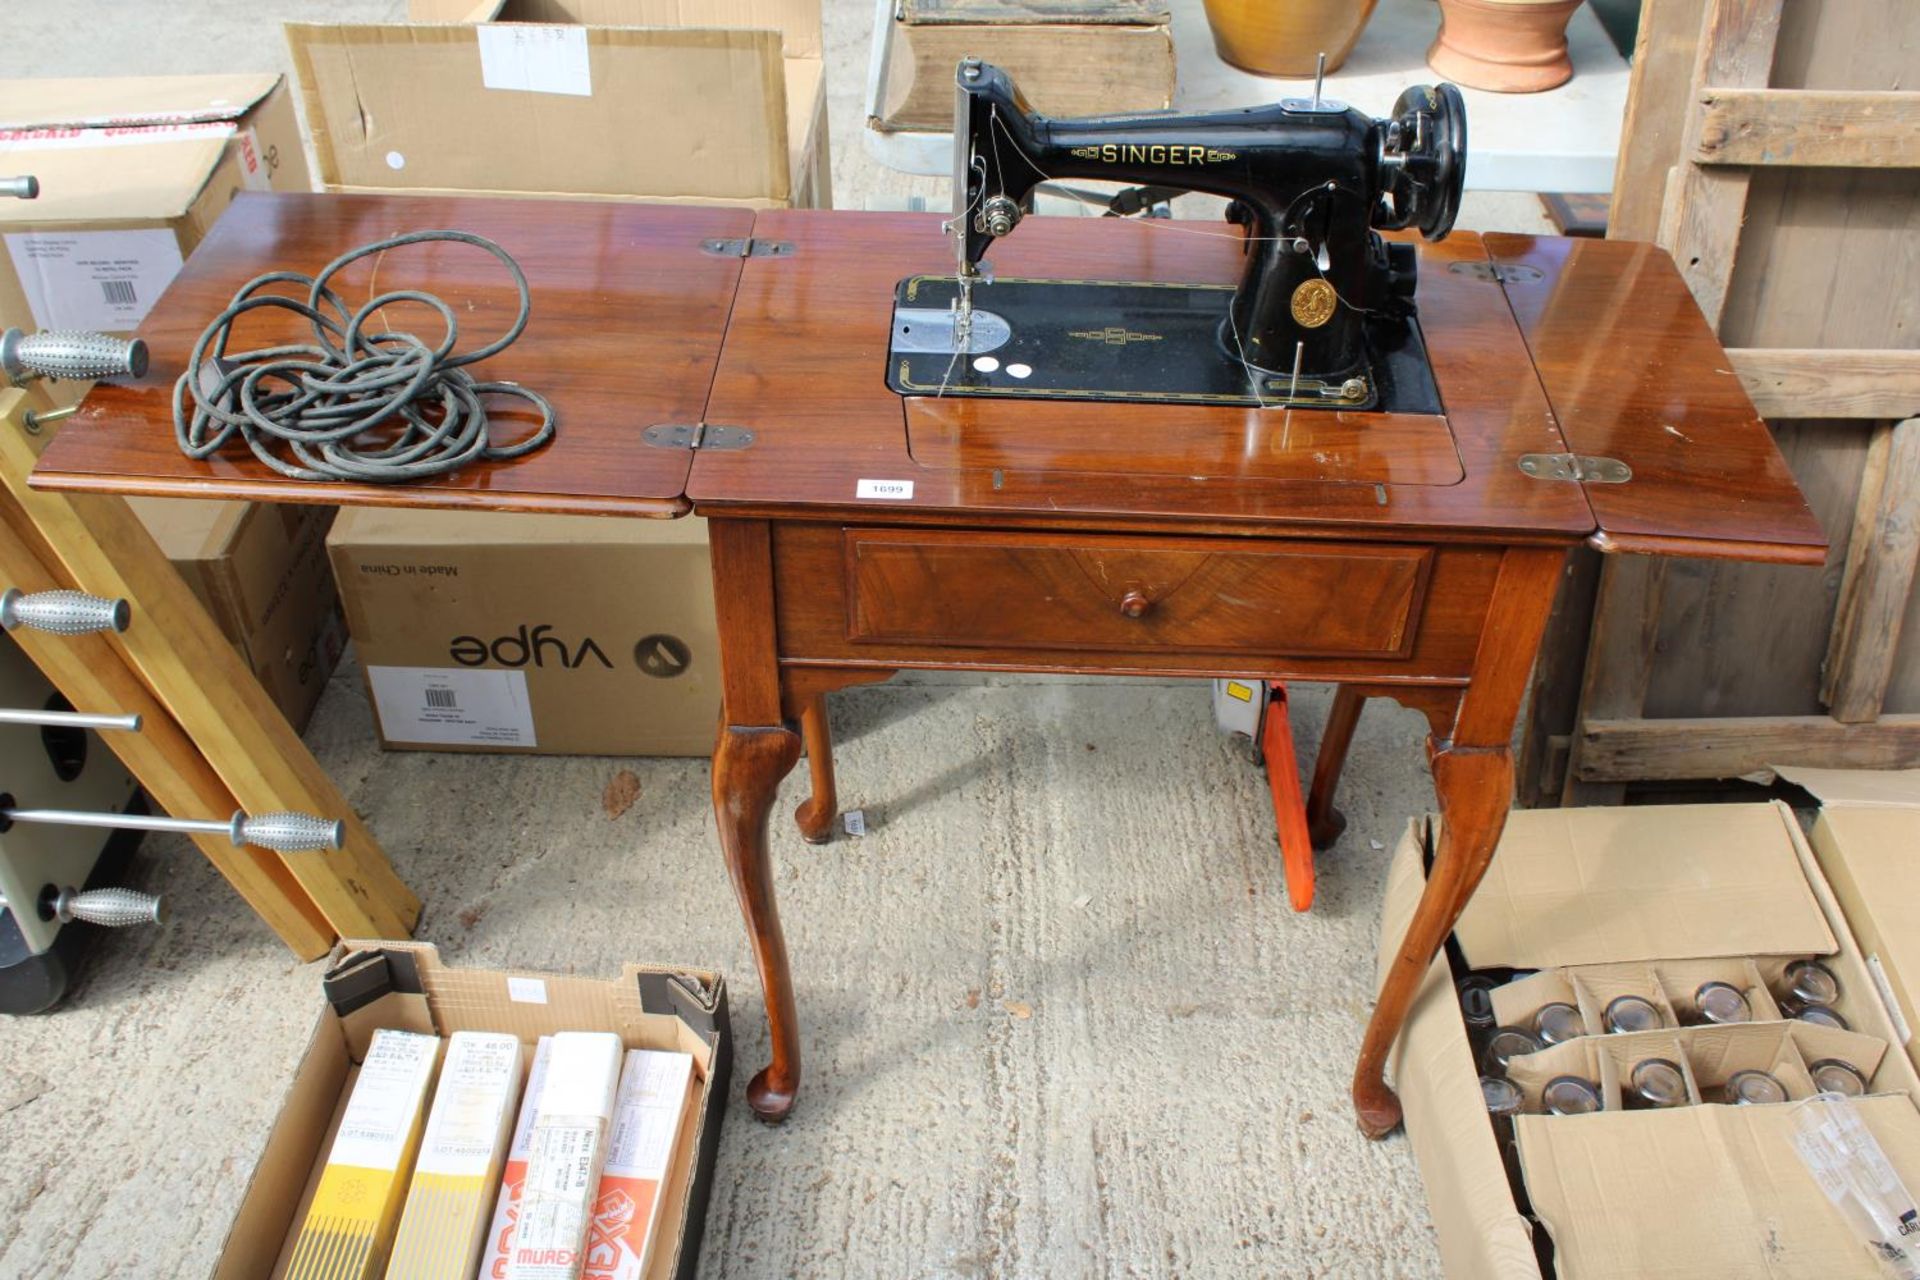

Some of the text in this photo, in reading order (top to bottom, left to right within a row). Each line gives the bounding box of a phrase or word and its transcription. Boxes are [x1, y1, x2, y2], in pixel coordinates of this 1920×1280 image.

[1102, 144, 1204, 165] SINGER
[873, 485, 903, 493] 1699
[360, 564, 457, 576] Made in China
[450, 624, 614, 669] vype
[516, 1250, 578, 1265] MUREX
